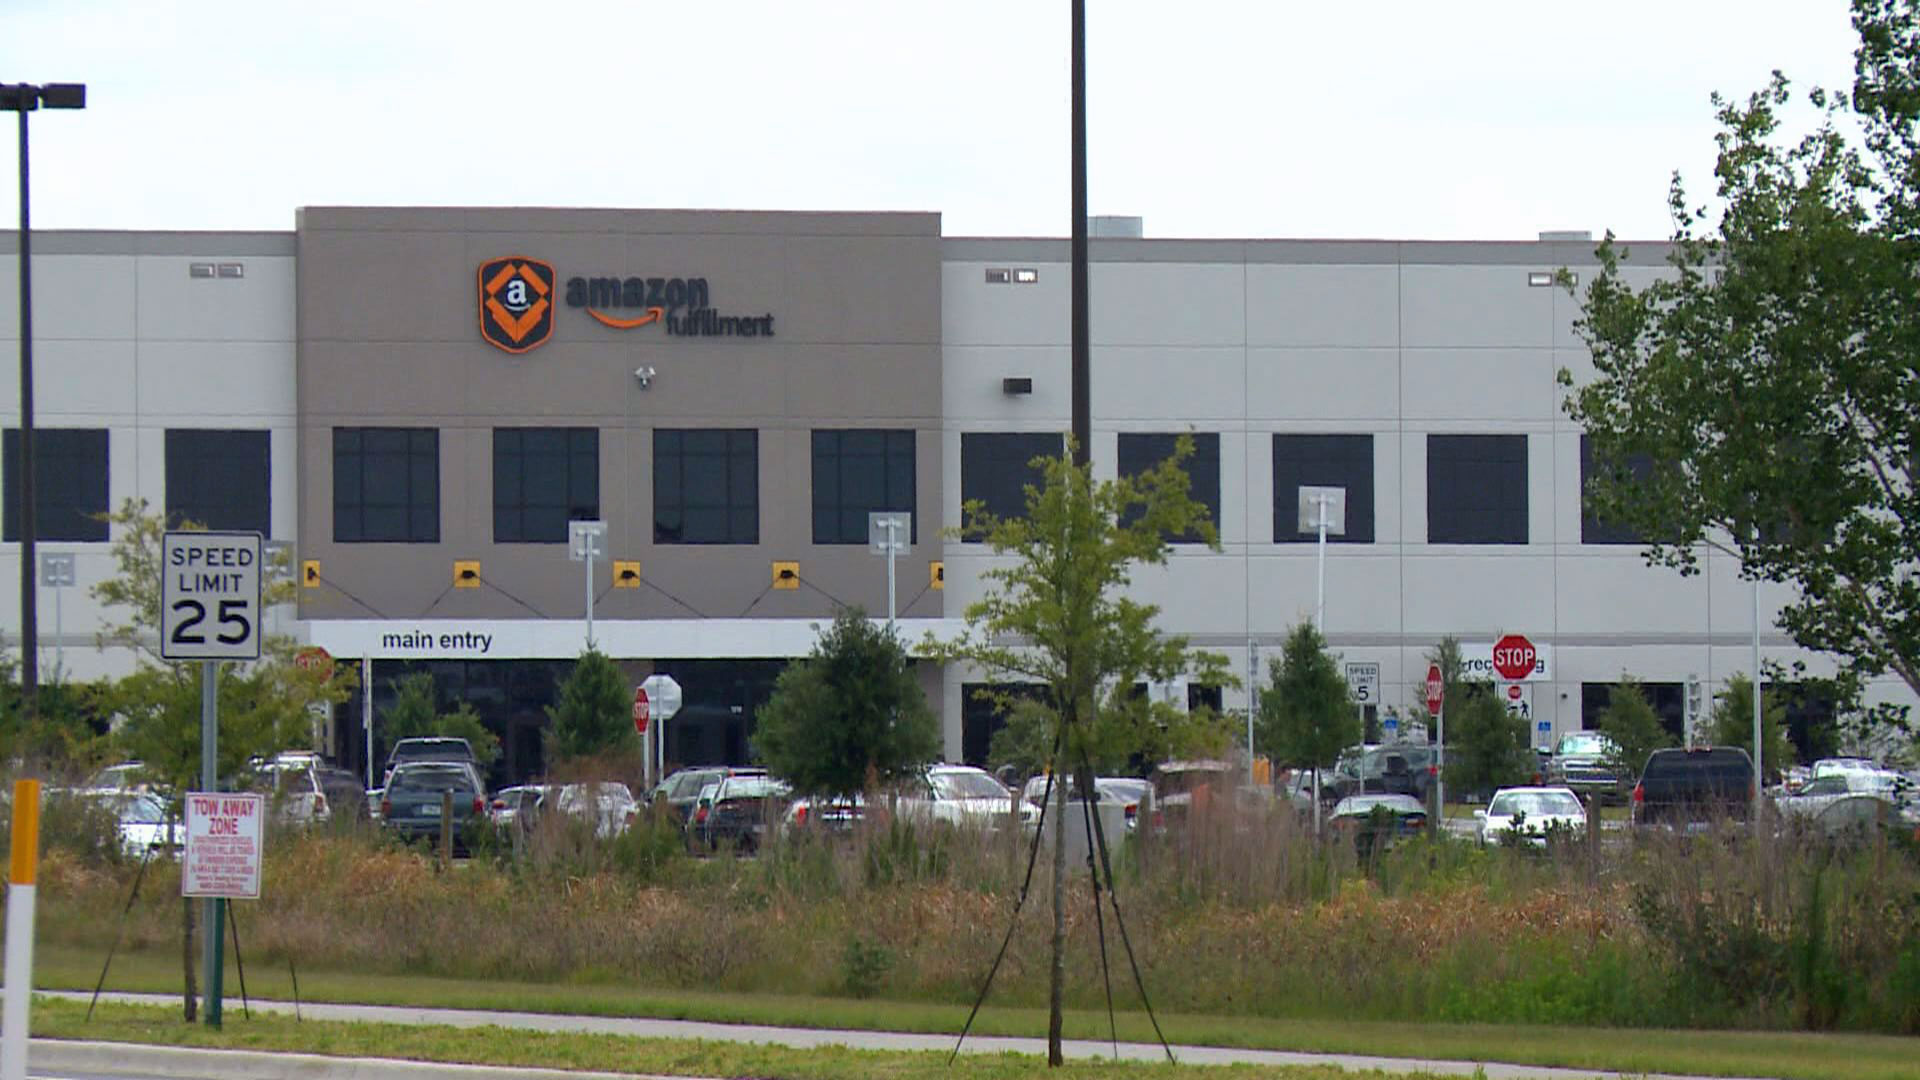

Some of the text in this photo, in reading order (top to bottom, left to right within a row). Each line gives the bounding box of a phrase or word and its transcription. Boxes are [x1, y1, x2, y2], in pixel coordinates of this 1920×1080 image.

[507, 277, 527, 304] a
[566, 276, 709, 308] amazon
[666, 308, 775, 337] fulfillment
[171, 547, 253, 566] SPEED
[179, 573, 243, 592] LIMIT
[171, 600, 251, 645] 25
[382, 630, 492, 653] main entry
[1495, 647, 1534, 667] STOP
[1349, 667, 1377, 675] SPEED
[1351, 676, 1374, 684] LIMIT
[1358, 685, 1369, 701] 5
[1426, 681, 1442, 701] STOP
[634, 702, 649, 720] STOP
[193, 799, 255, 817] TOW AWAY
[208, 817, 238, 835] ZONE
